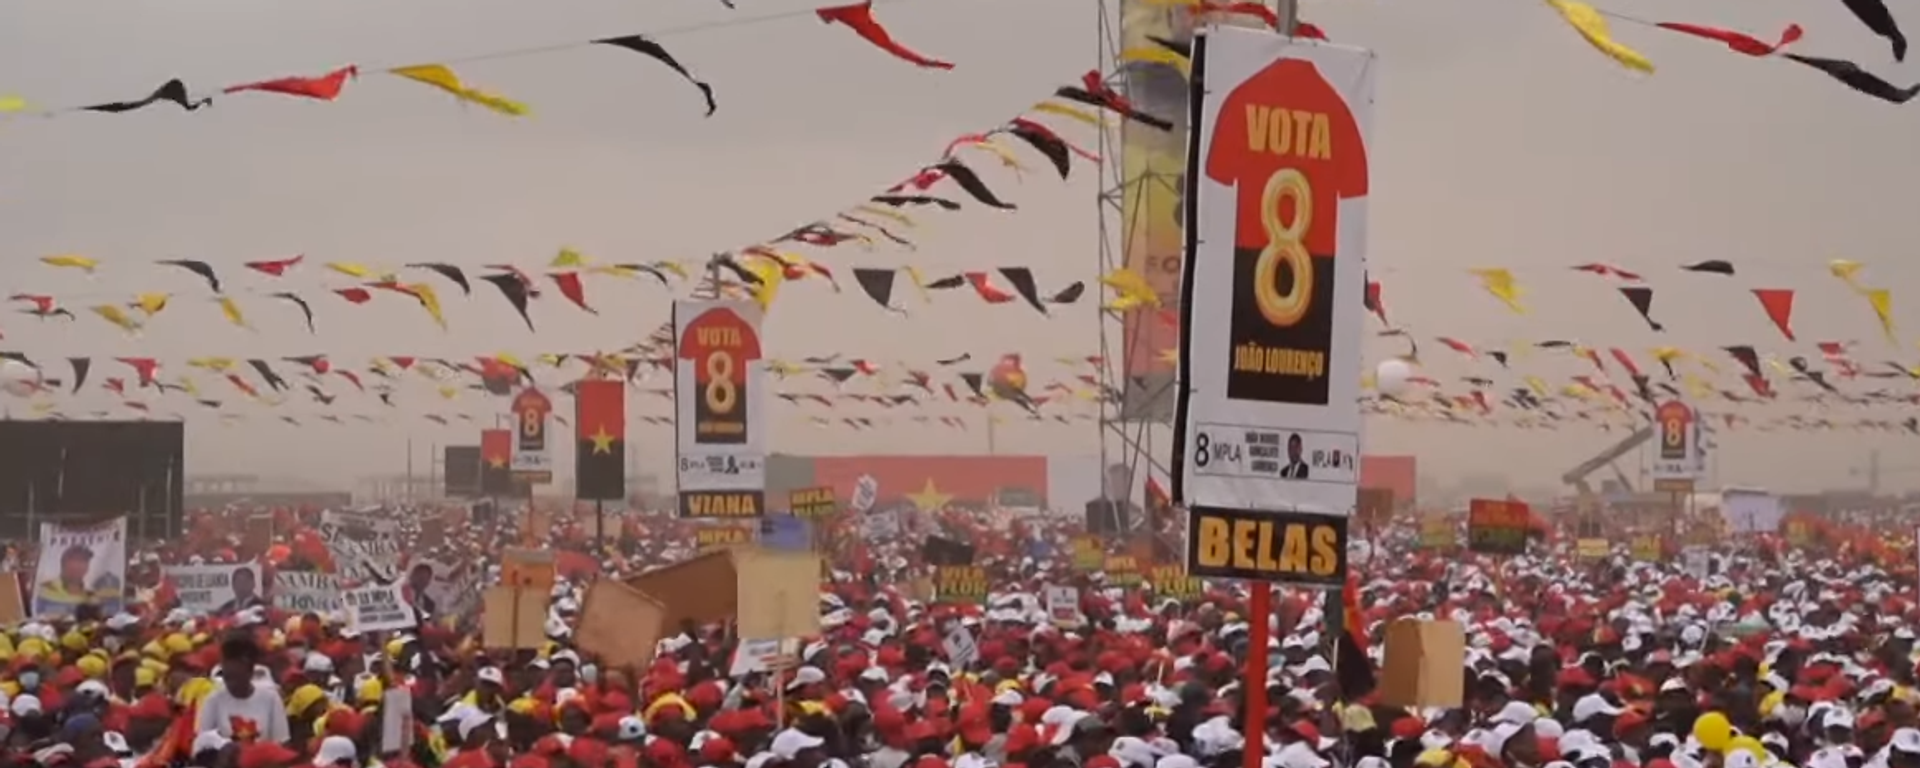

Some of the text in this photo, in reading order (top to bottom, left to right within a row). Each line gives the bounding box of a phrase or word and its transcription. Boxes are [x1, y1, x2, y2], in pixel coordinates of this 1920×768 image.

[1246, 104, 1331, 160] VOTA
[1254, 168, 1313, 327] 8
[697, 327, 742, 346] VOTA
[1234, 342, 1323, 380] JOÃO LOURENÇO
[706, 351, 736, 414] 8
[524, 408, 539, 436] 8
[1666, 419, 1680, 447] 8
[1195, 432, 1242, 467] 8 MPLA
[688, 493, 756, 515] VIANA
[698, 527, 746, 544] MPLA
[1198, 516, 1338, 576] BELAS
[940, 579, 988, 595] FLOR
